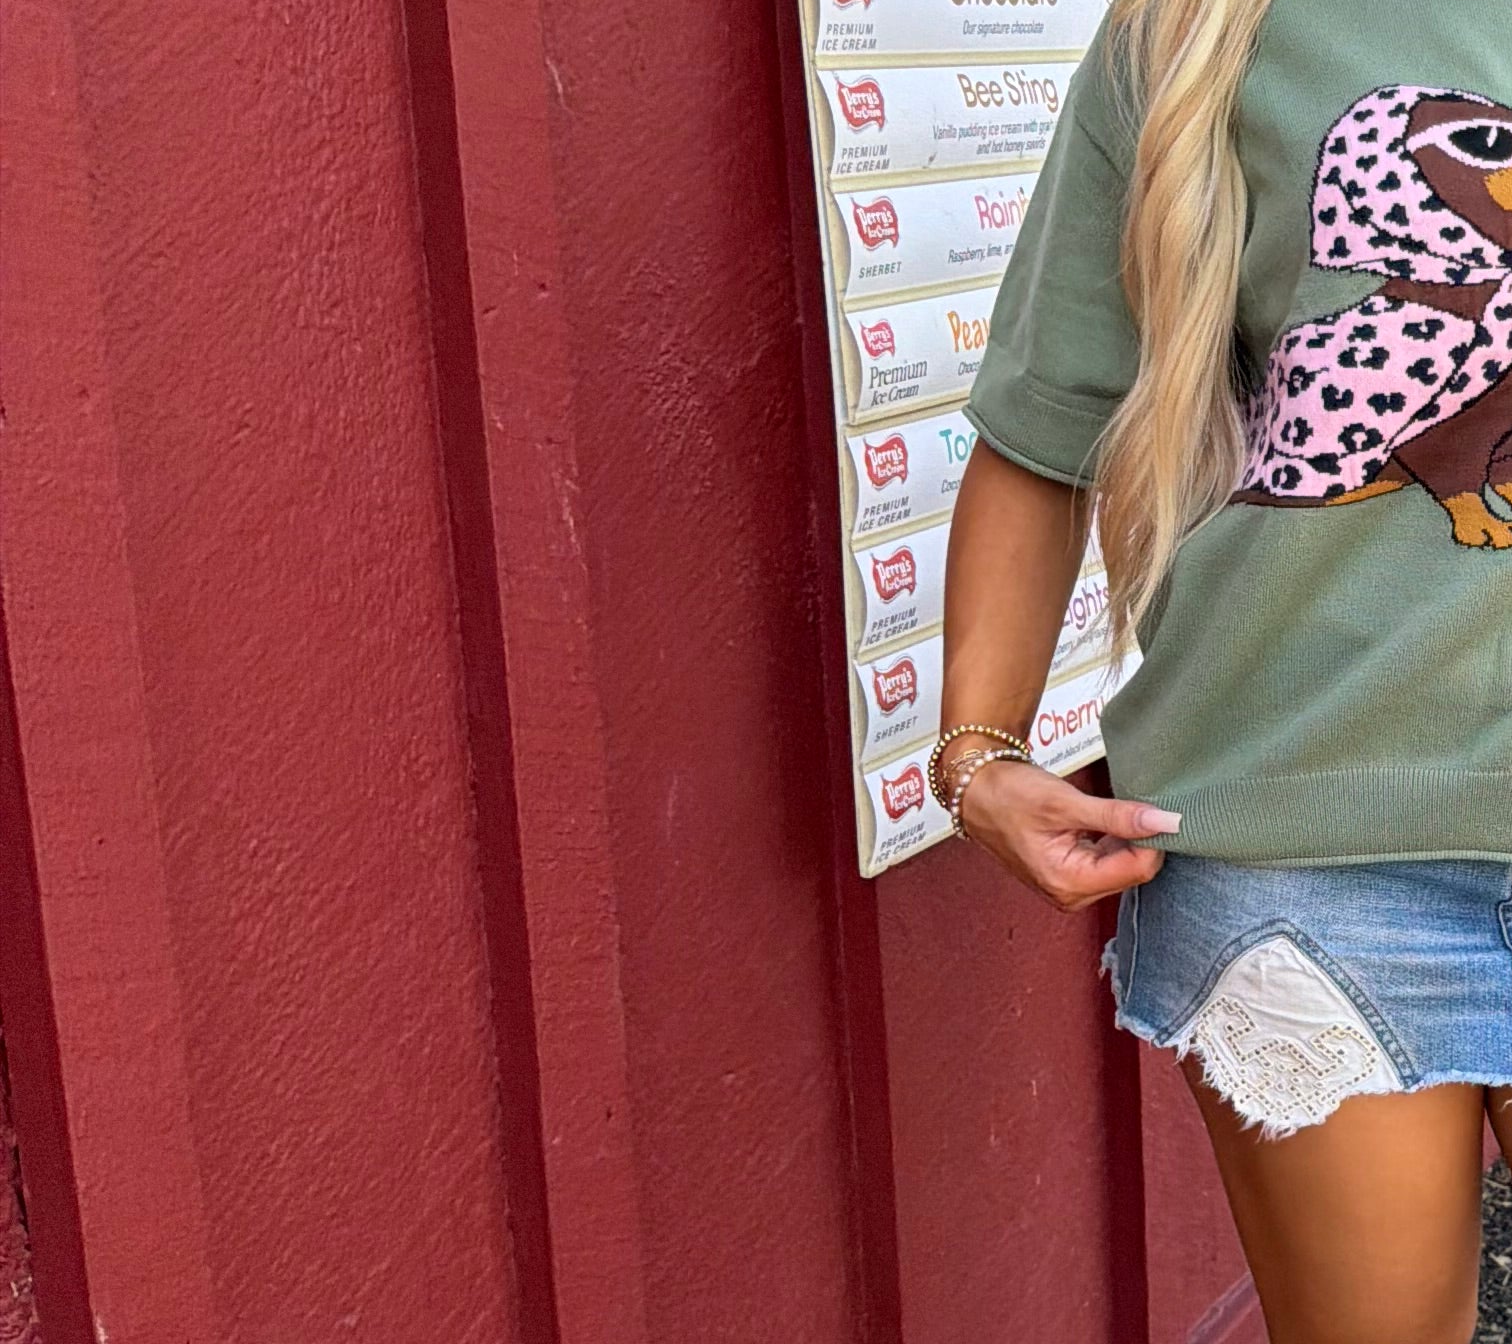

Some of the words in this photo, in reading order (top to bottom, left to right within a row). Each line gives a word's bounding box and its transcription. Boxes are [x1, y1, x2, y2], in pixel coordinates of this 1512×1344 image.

[826, 23, 874, 35] PREMIUM
[962, 20, 977, 35] Our
[978, 21, 1009, 38] signature
[1011, 21, 1044, 35] chocolate
[822, 39, 838, 50] ICE
[841, 38, 876, 50] CREAM
[957, 72, 1002, 108] Bee
[1003, 70, 1058, 113] Sting
[841, 145, 888, 158] PREMIUM
[836, 160, 853, 174] ICE
[855, 158, 890, 173] CREAM
[858, 261, 902, 278] SHERBET
[870, 358, 927, 388] Premium
[870, 389, 886, 406] Ice
[887, 383, 919, 403] Cream
[867, 438, 905, 475] Perry's
[858, 517, 876, 533] ICE
[877, 507, 911, 528] CREAM
[863, 495, 909, 519] PREMIUM
[865, 628, 883, 645] ICE
[884, 618, 918, 640] CREAM
[871, 606, 916, 633] PREMIUM
[874, 716, 918, 743] SHERBET
[875, 847, 893, 864] ICE
[892, 831, 927, 857] CREAM
[880, 821, 926, 853] PREMIUM
